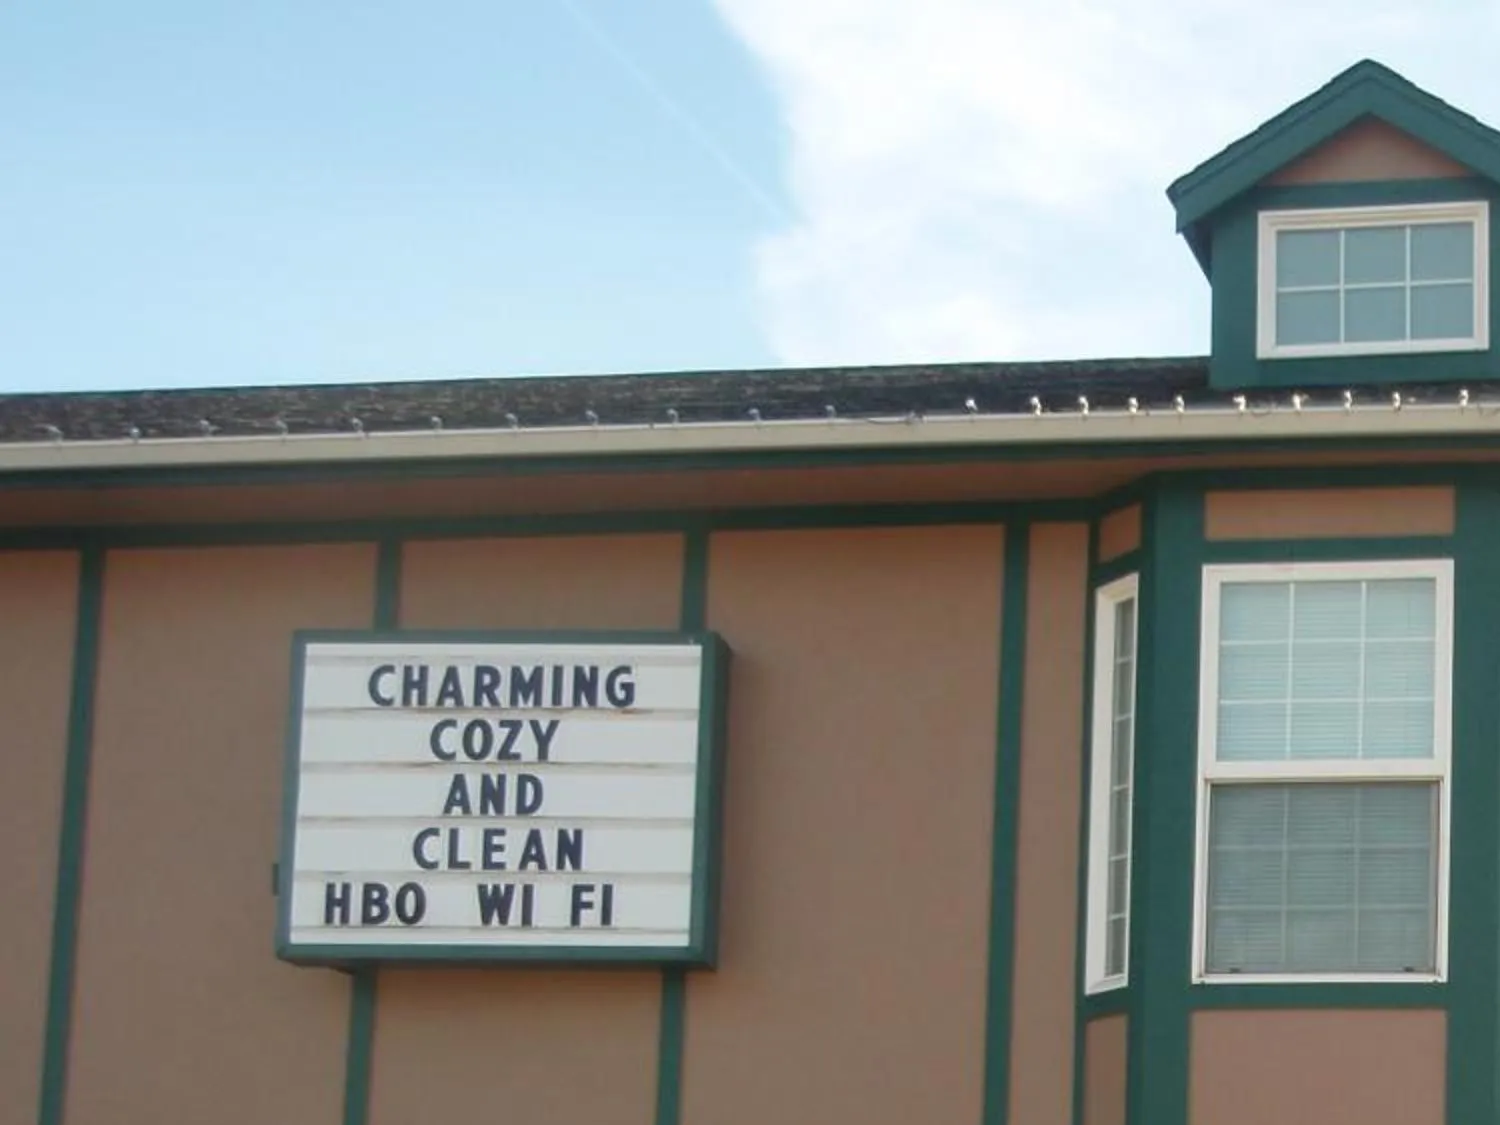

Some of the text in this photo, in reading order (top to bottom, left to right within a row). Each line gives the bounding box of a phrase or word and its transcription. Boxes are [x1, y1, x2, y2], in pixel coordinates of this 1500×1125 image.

[368, 664, 637, 708] CHARMING
[429, 718, 561, 761] COZY
[442, 773, 544, 817] AND
[412, 827, 584, 871] CLEAN
[323, 881, 614, 927] HBO WI FI
